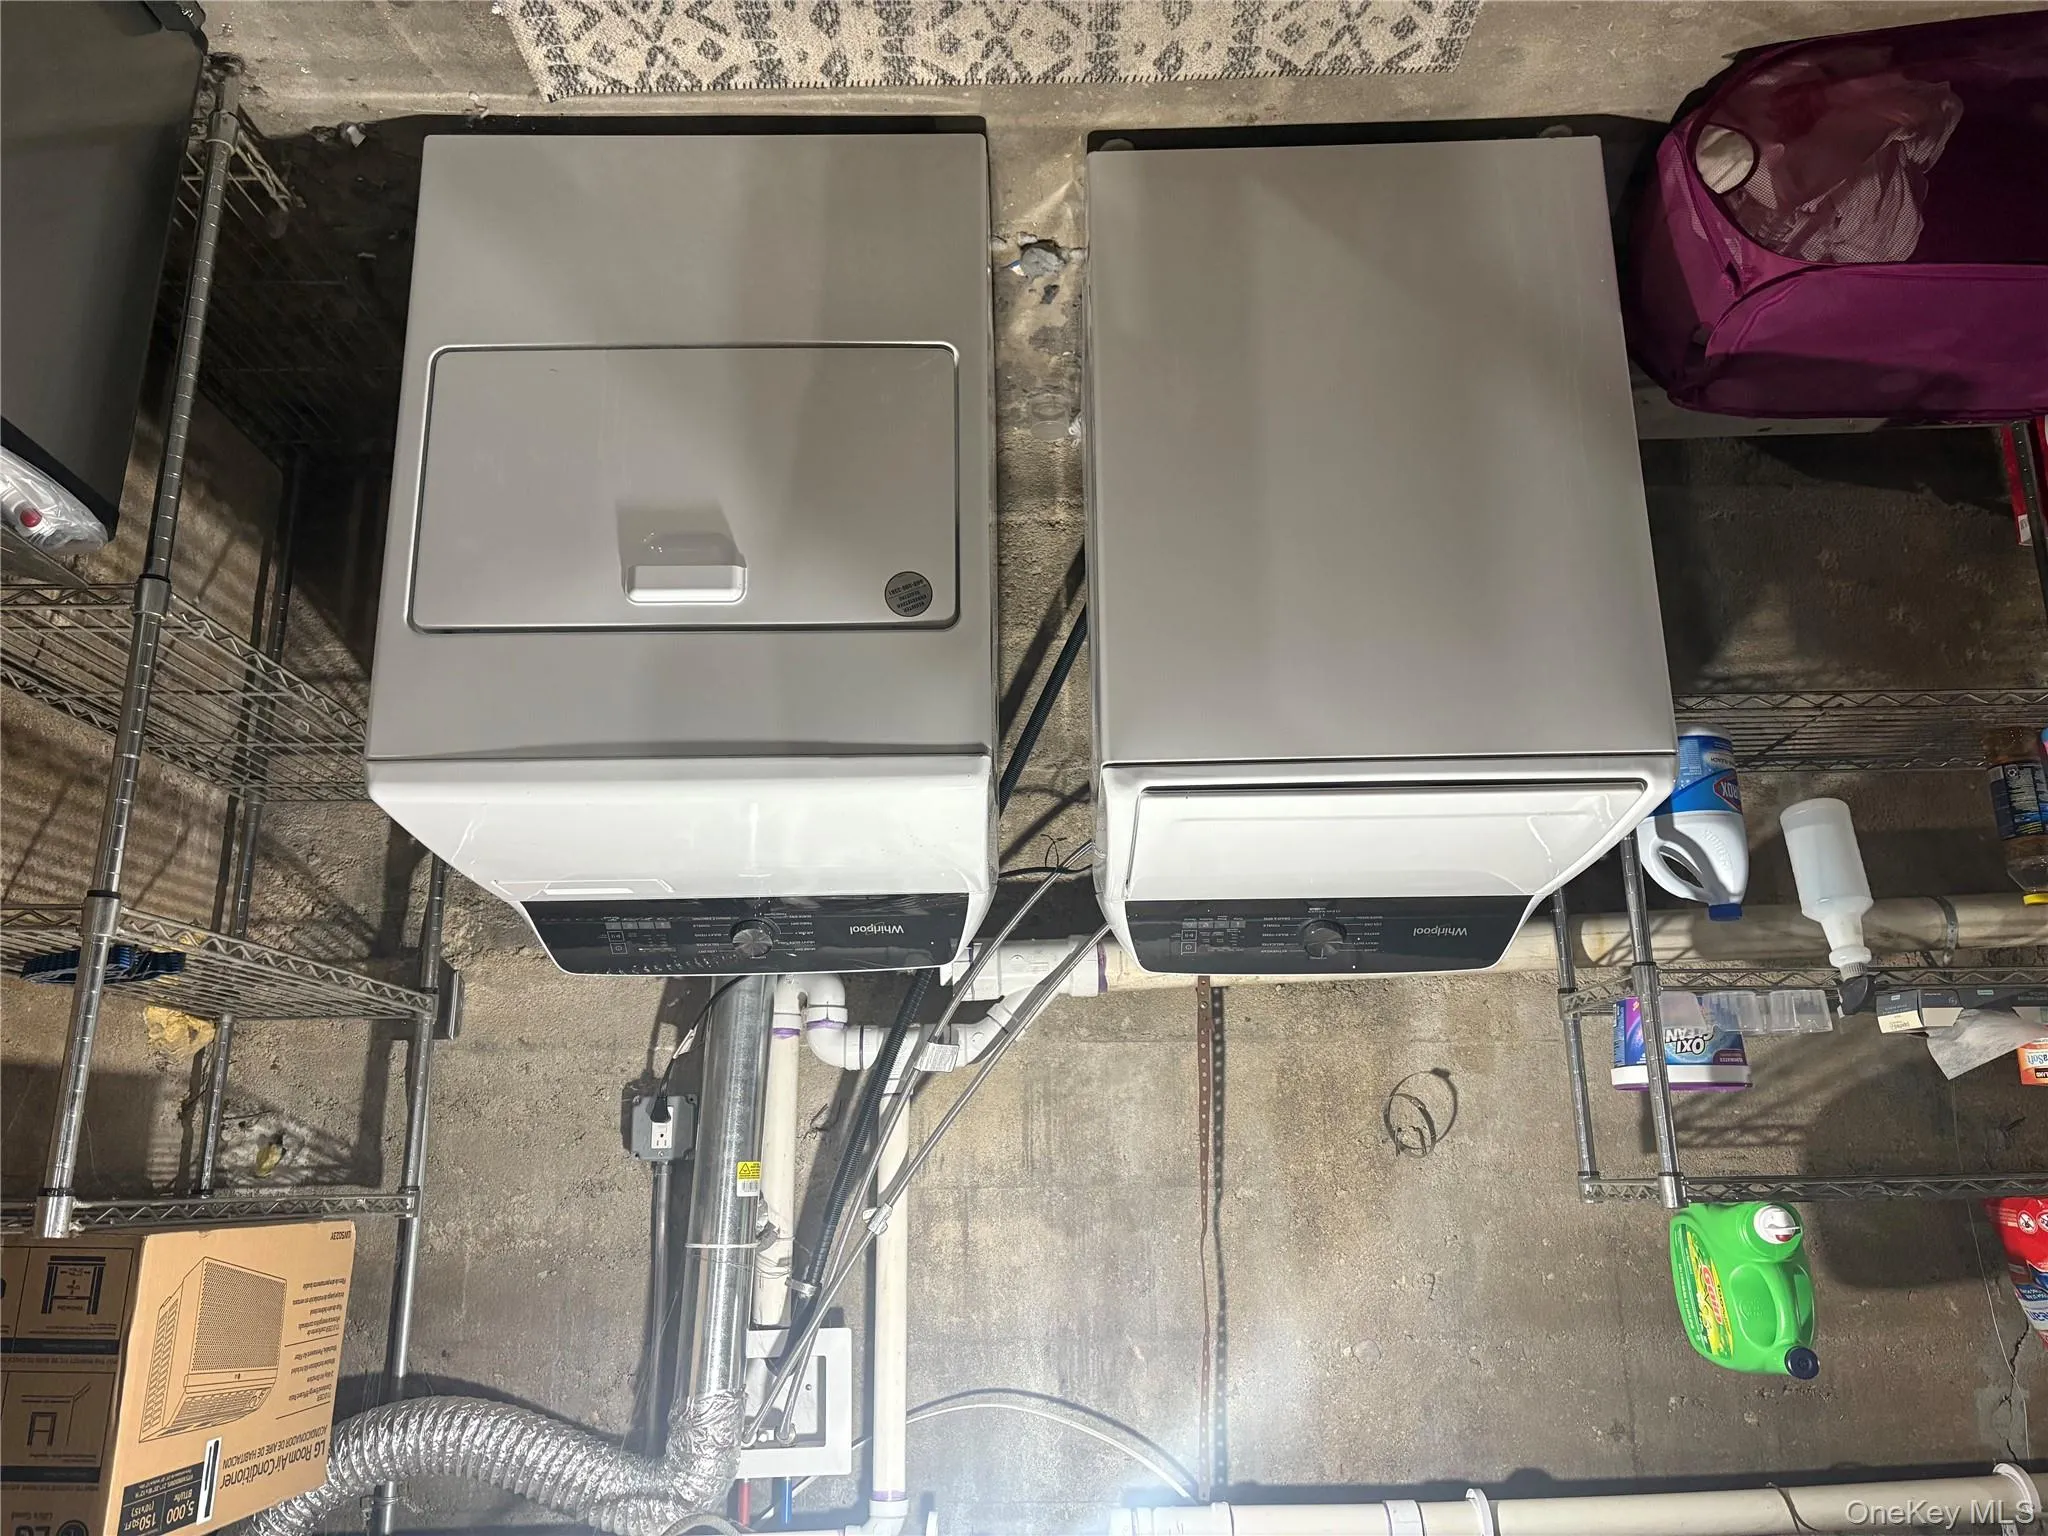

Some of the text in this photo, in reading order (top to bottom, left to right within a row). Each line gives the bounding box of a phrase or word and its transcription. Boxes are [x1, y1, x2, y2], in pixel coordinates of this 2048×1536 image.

[850, 923, 905, 935] Whirlpool
[1413, 925, 1468, 937] Whirlpool
[1676, 1037, 1705, 1055] OXI
[1703, 1266, 1722, 1324] Gain
[258, 1446, 265, 1458] DE
[266, 1442, 277, 1454] AIRE
[220, 1439, 326, 1489] LG Room Air Conditioner
[139, 1511, 156, 1531] 150
[166, 1500, 195, 1525] 5,000
